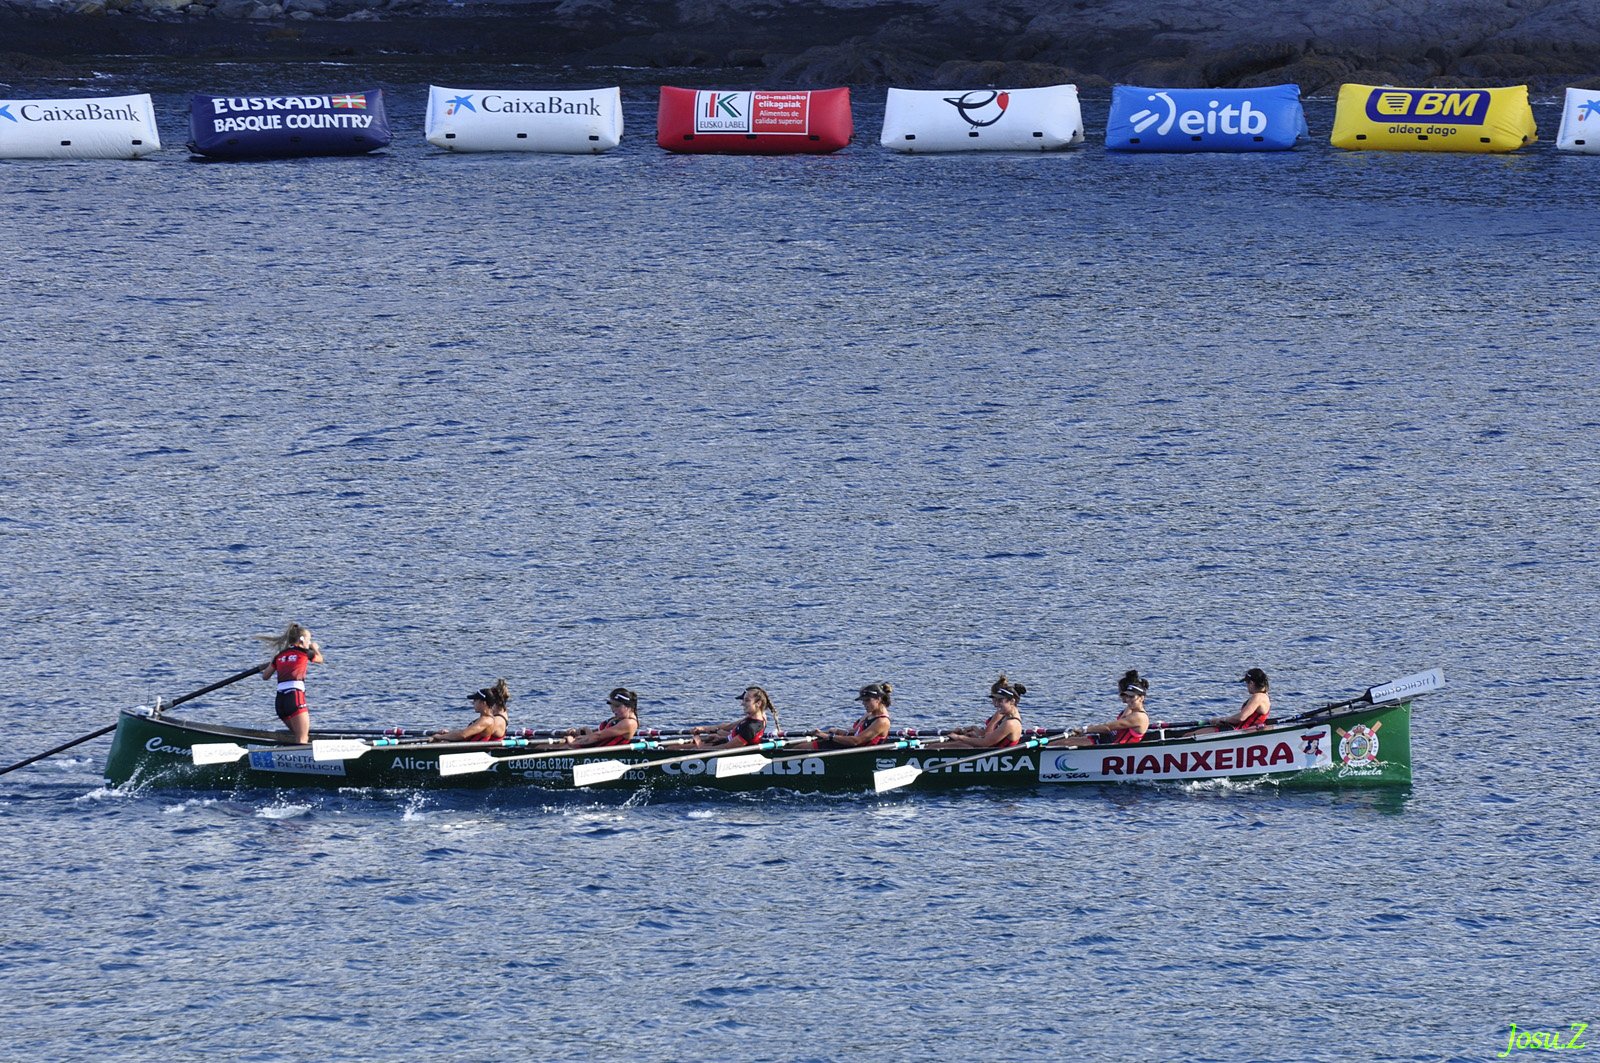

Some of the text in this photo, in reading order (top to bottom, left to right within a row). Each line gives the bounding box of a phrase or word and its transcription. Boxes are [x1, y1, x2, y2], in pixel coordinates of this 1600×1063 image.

[21, 104, 141, 122] CaixaBank
[212, 96, 331, 114] EUSKADI
[481, 95, 602, 116] CaixaBank
[759, 101, 801, 109] elikagaiak
[1415, 92, 1480, 117] BM
[213, 114, 373, 133] BASQUE COUNTRY
[700, 121, 746, 129] EUSKO LABEL
[779, 118, 803, 126] superior
[1179, 100, 1267, 135] eitb
[1388, 125, 1457, 137] aldea dago
[294, 763, 341, 771] GALICIA
[391, 757, 440, 770] Alicru
[508, 759, 535, 769] CABO
[536, 758, 547, 769] da
[548, 758, 574, 770] CRUZ
[905, 755, 1035, 773] ACTEMSA
[1102, 742, 1294, 776] RIANXEIRA
